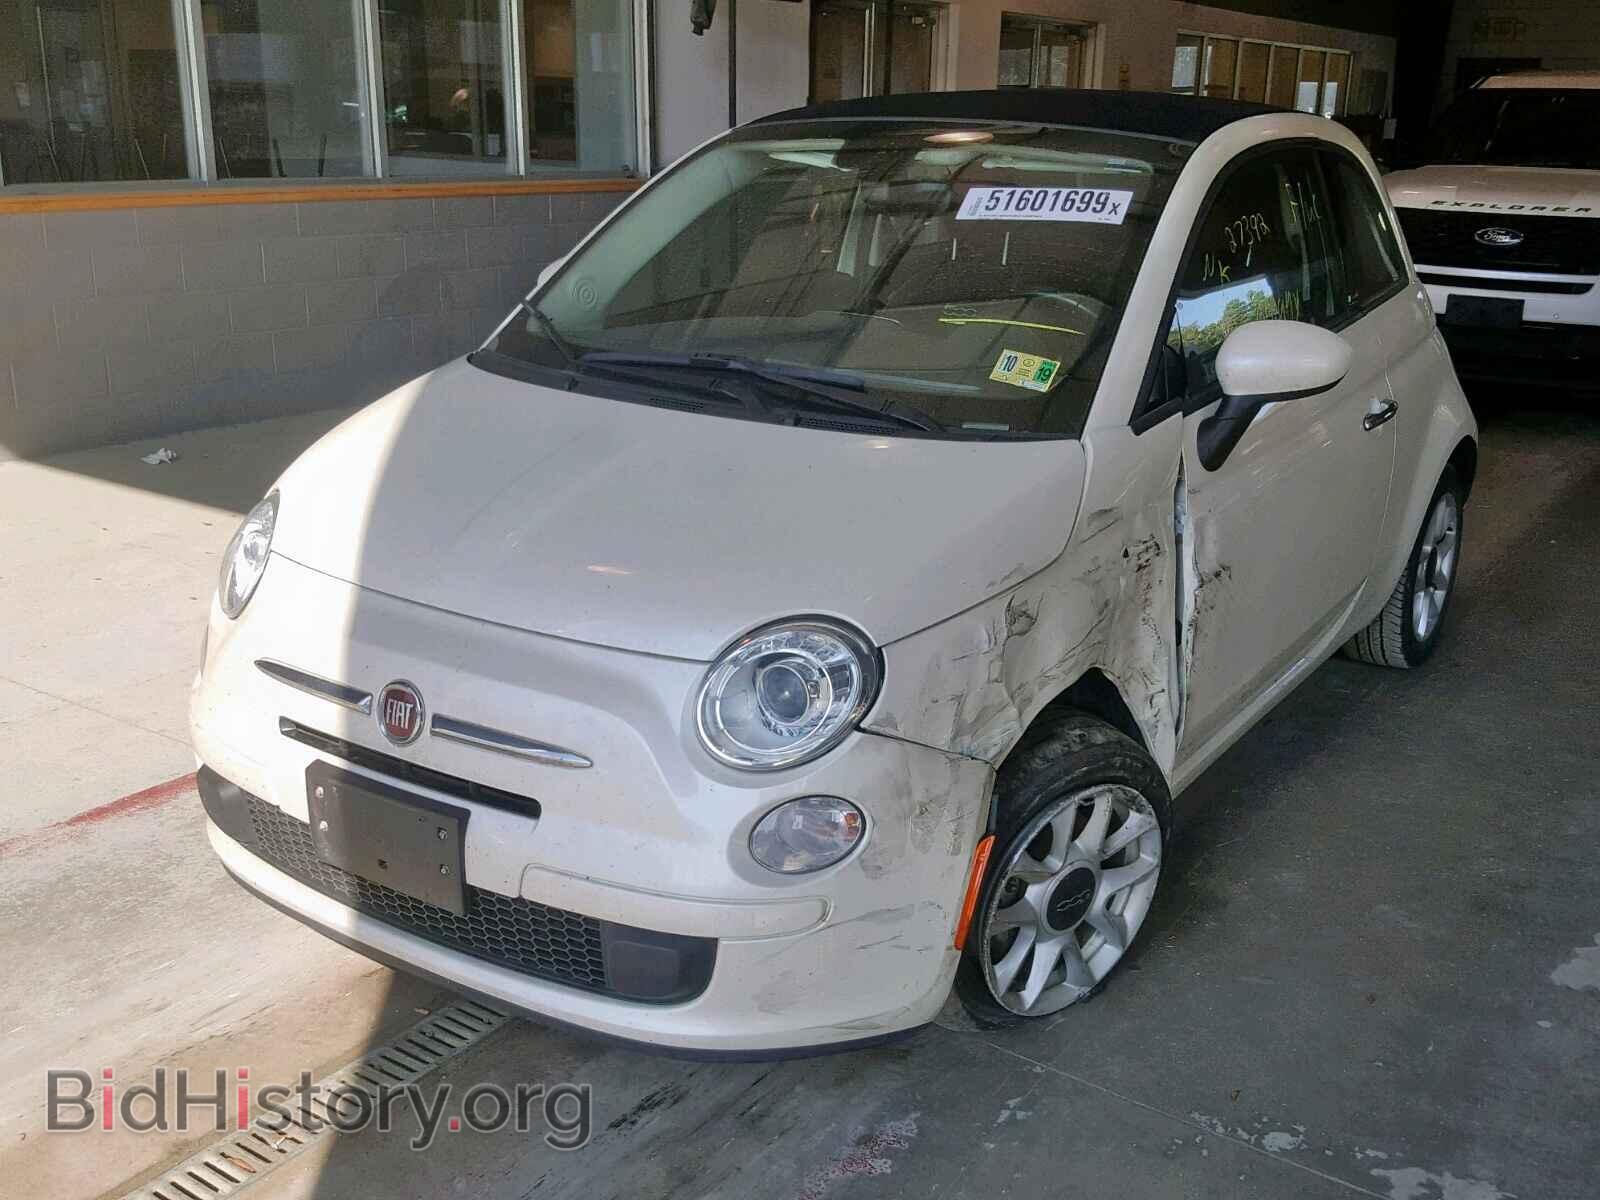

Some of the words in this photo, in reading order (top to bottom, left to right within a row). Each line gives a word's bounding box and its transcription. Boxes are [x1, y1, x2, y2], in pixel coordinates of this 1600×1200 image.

[1002, 355, 1018, 373] 10
[1036, 366, 1052, 382] 19
[386, 698, 414, 730] FIAT
